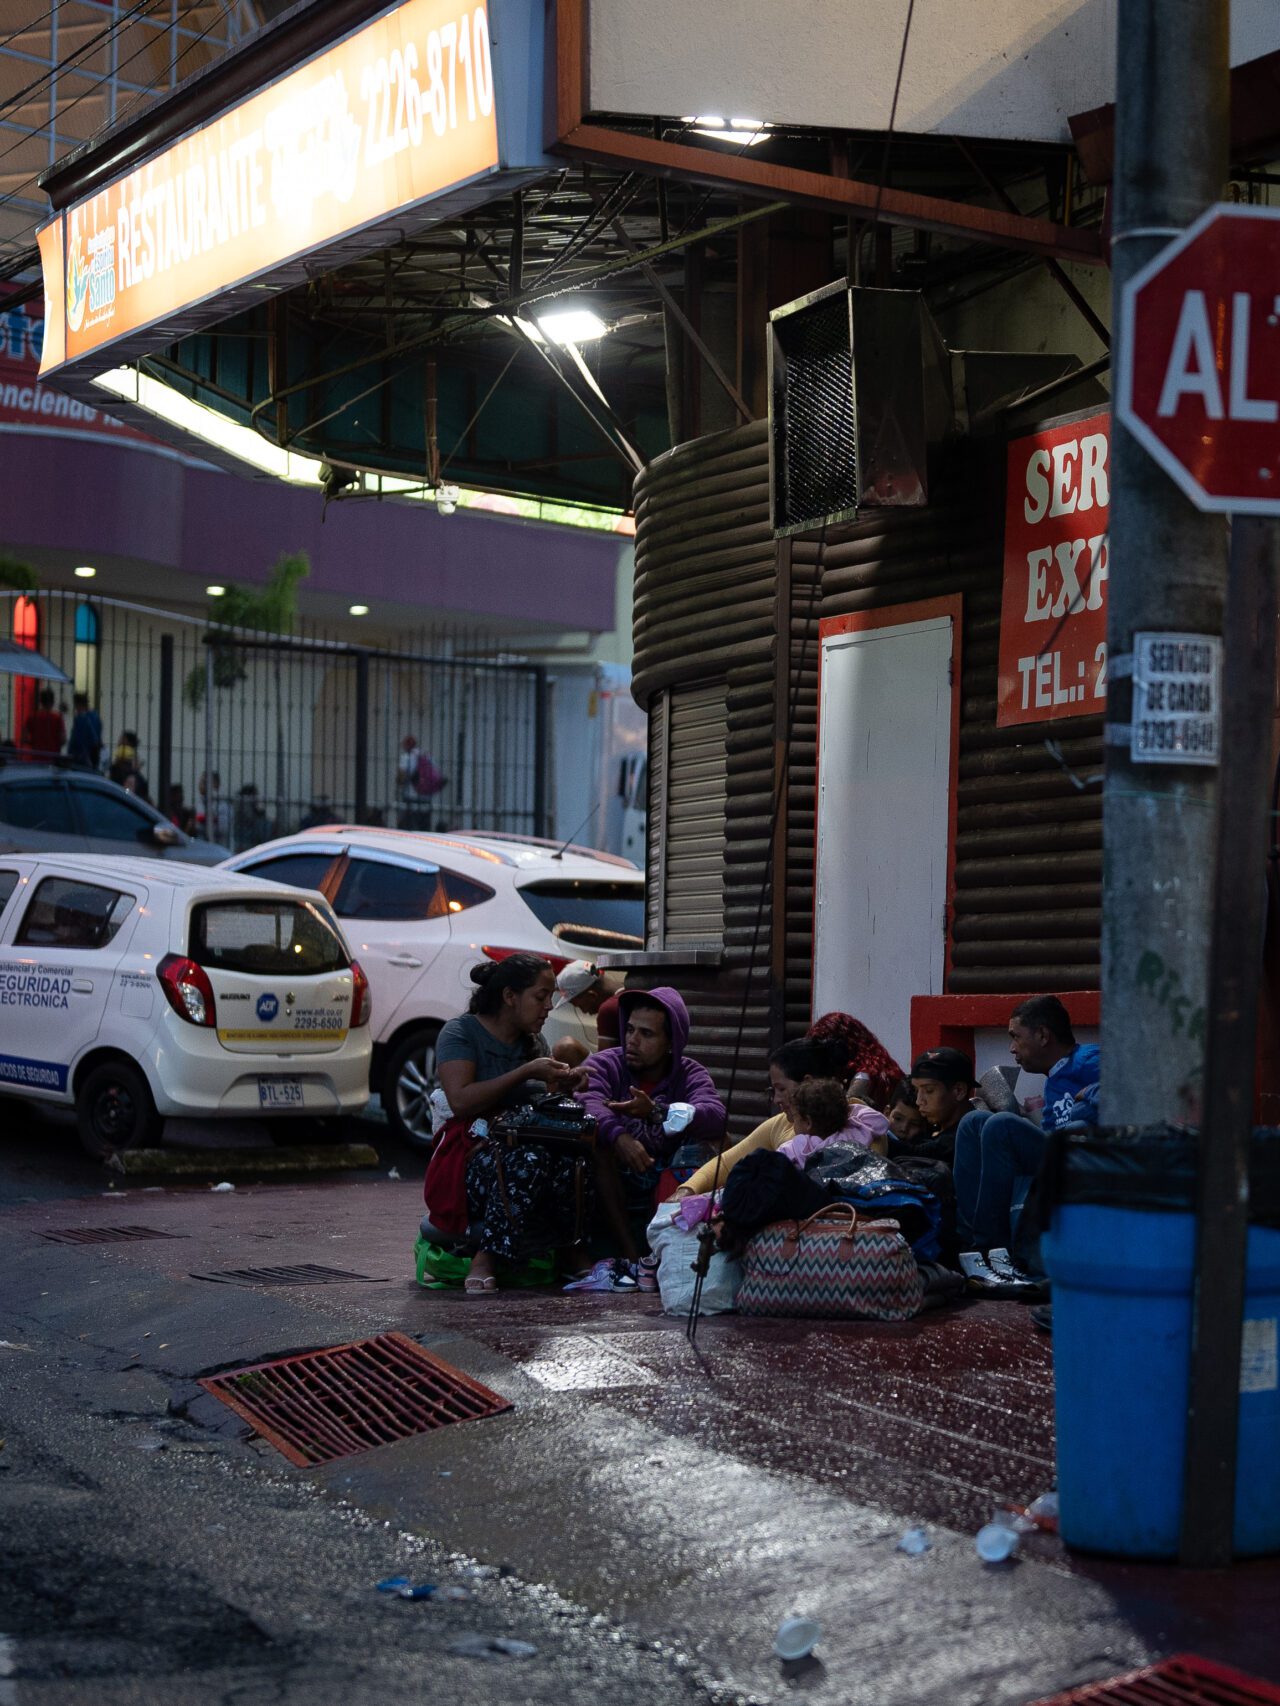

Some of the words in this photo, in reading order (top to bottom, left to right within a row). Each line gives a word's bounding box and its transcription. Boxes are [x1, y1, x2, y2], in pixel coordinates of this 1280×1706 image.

[117, 126, 267, 292] RESTAURANTE
[360, 6, 493, 167] 2226-8710
[89, 268, 116, 313] Santo
[0, 383, 98, 423] nciende
[1024, 433, 1110, 525] SER
[1024, 534, 1109, 623] EXP
[1149, 643, 1211, 673] SERVICIO
[1147, 682, 1164, 711] DE
[37, 965, 74, 976] Comercial
[0, 990, 69, 1010] ECTRONICA
[259, 1001, 276, 1012] ADT
[294, 1017, 343, 1029] 2295-6500
